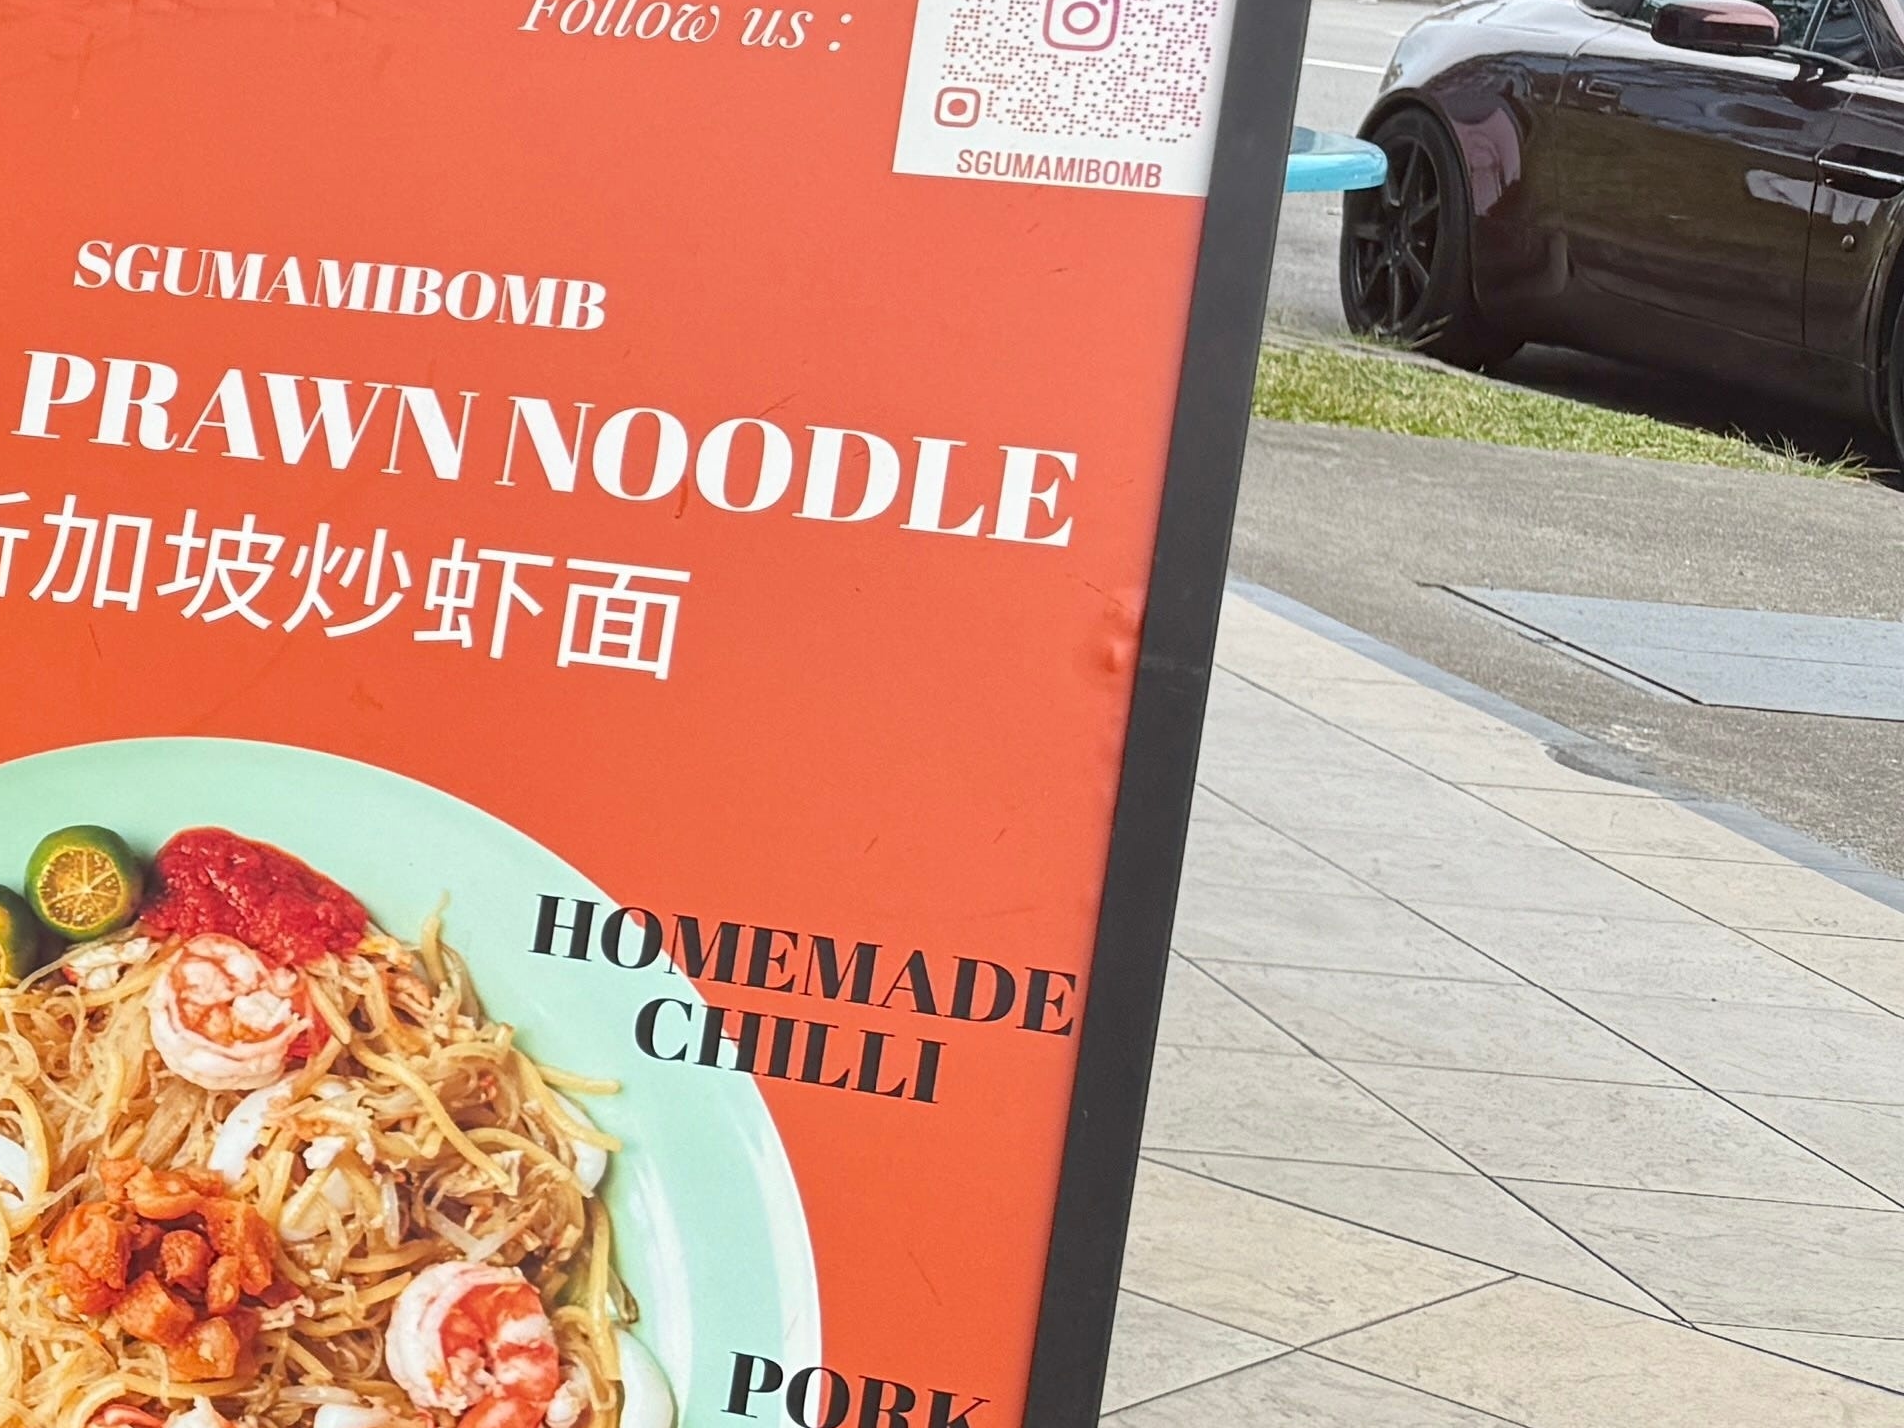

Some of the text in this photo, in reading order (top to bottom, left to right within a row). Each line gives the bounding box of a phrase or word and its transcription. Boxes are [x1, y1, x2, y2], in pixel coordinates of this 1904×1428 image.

[741, 6, 814, 50] us
[956, 148, 1163, 190] SGUMAMIBOMB
[73, 239, 607, 332] SGUMAMIBOMB
[10, 348, 480, 483] PRAWN
[495, 393, 1078, 549] NOODLE
[528, 893, 1077, 1037] HOMEMADE
[633, 997, 949, 1105] CHILLI
